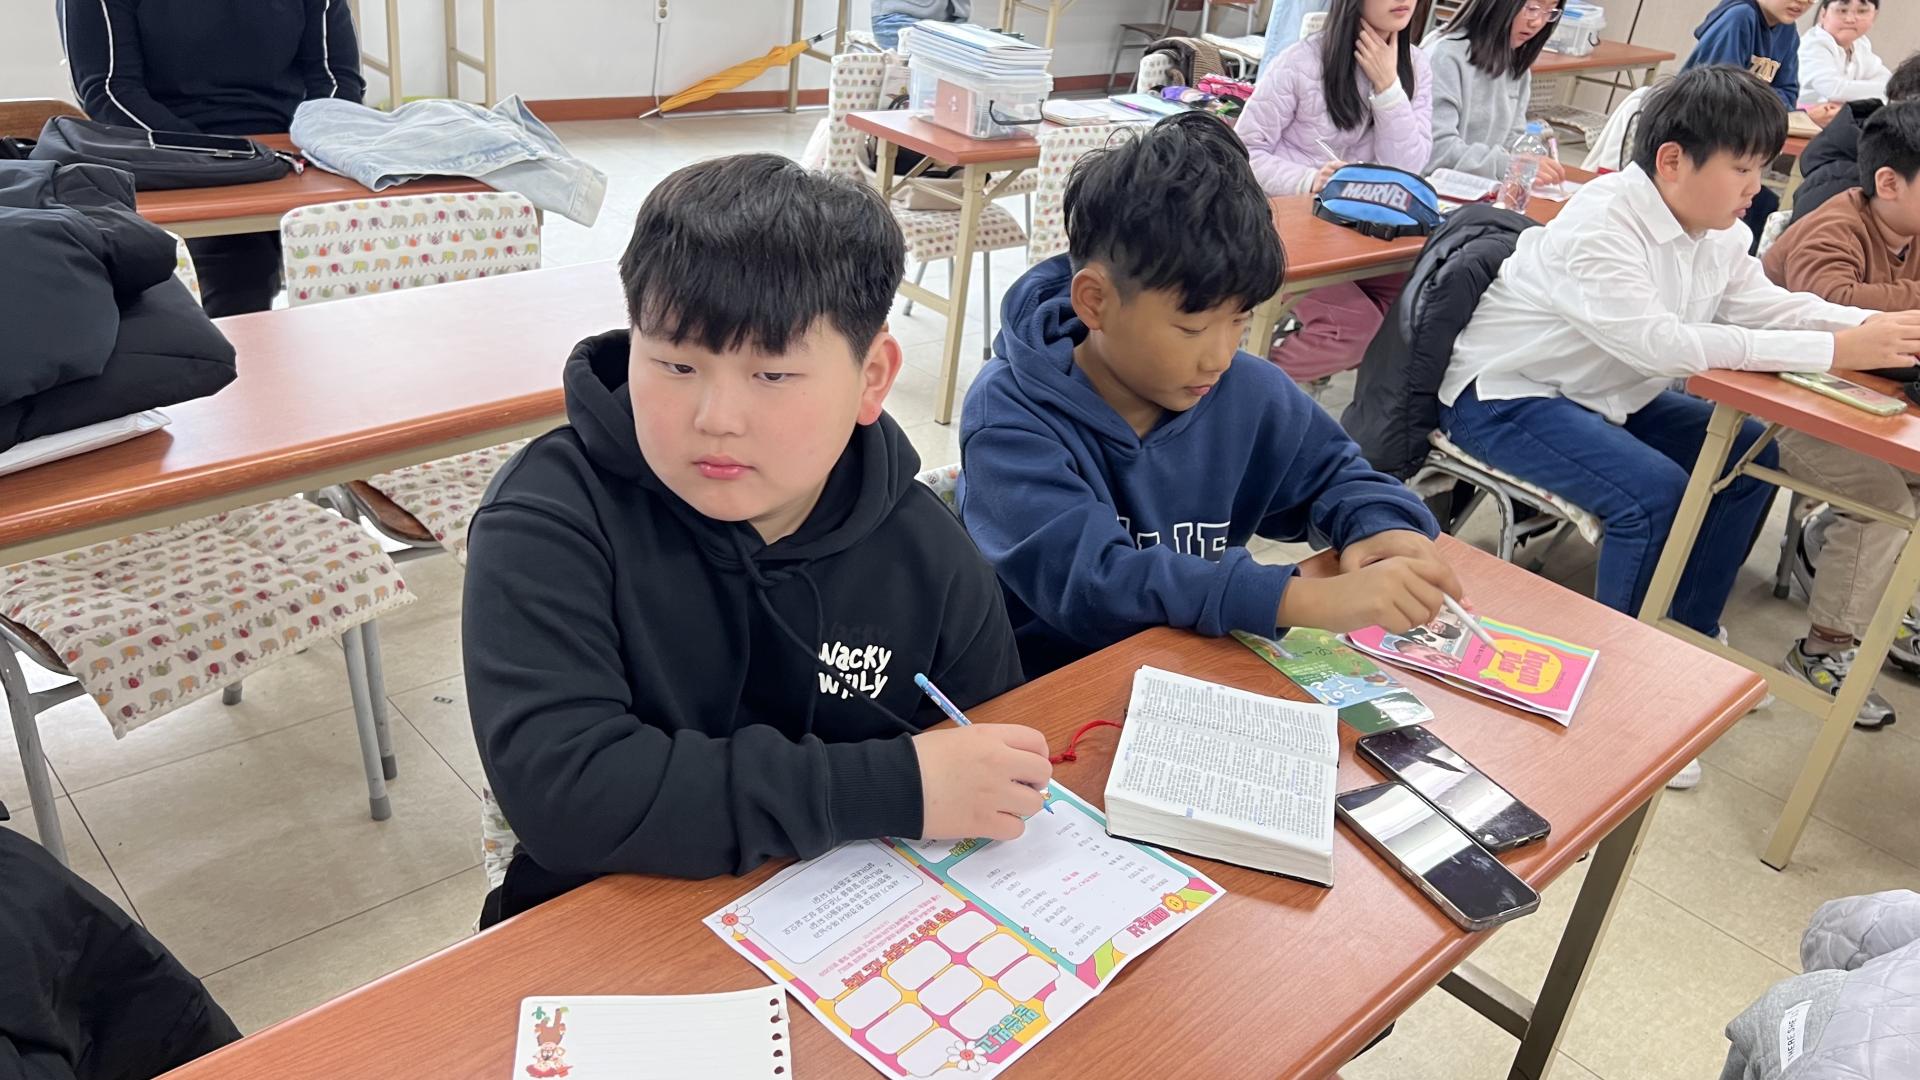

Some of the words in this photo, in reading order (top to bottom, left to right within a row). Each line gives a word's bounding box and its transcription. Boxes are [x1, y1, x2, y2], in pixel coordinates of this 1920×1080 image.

[1341, 182, 1410, 211] MARVEL
[813, 920, 840, 939] 예수님과
[975, 1004, 1041, 1054] 말씀빙고
